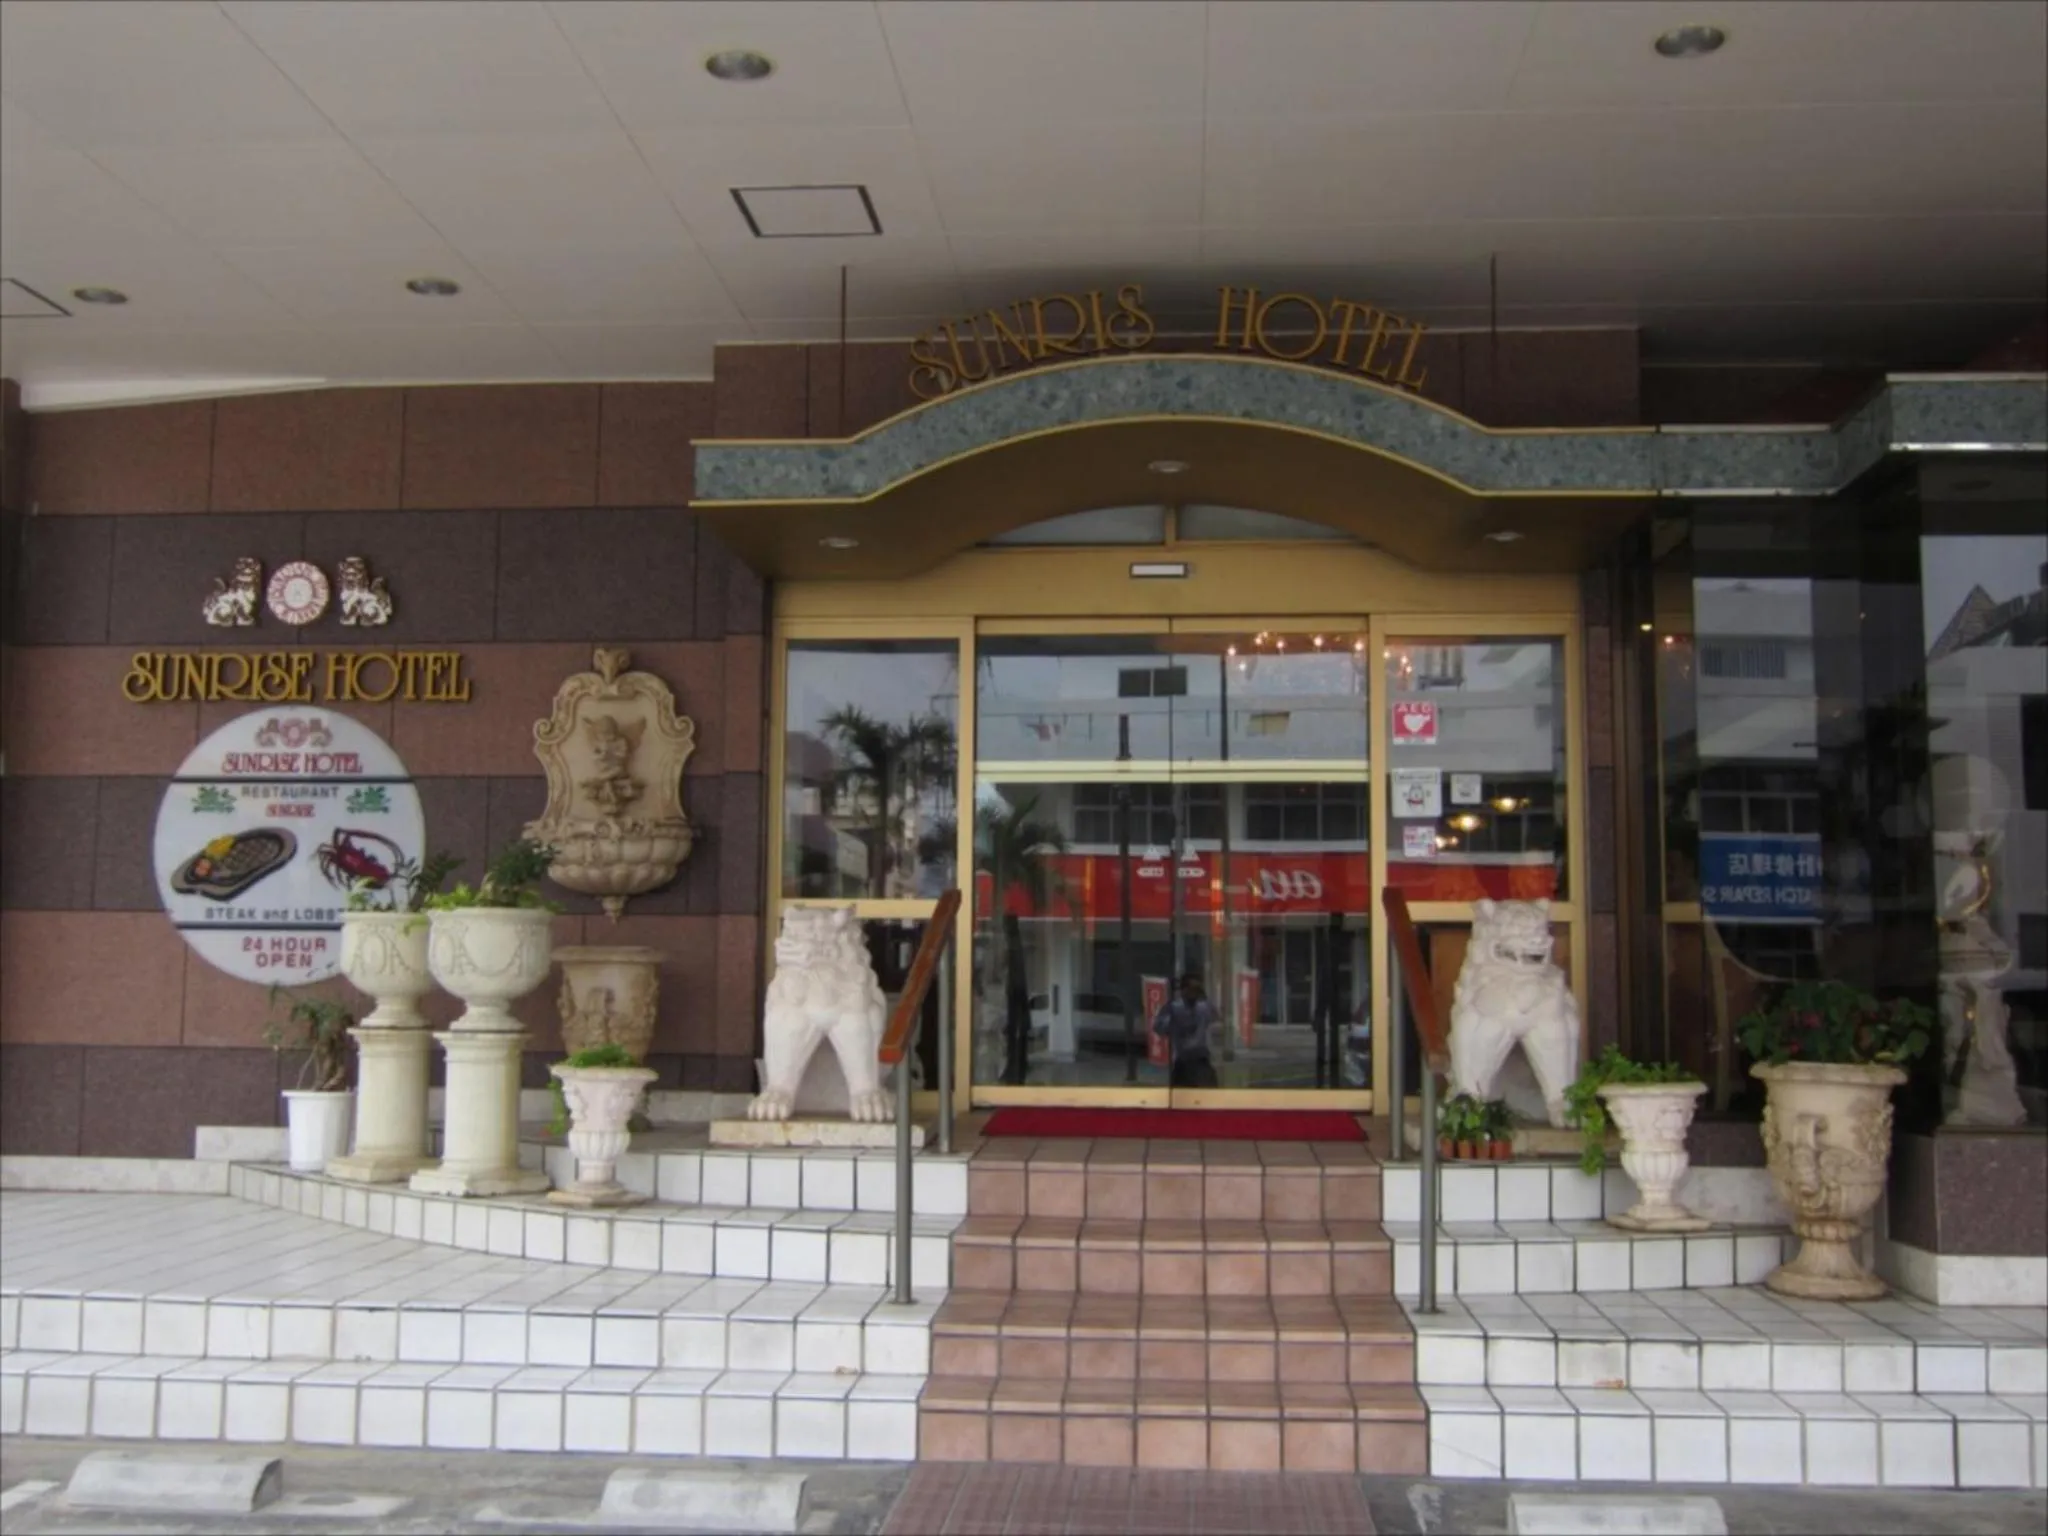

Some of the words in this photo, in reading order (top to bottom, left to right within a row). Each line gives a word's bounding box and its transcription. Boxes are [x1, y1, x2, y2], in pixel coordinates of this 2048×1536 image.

[909, 284, 1155, 401] SUNRIS
[1214, 285, 1429, 392] HOTEL
[121, 651, 313, 702] SUNRISE
[322, 651, 471, 702] HOTEL
[221, 753, 300, 774] SUNRISE
[304, 753, 363, 774] HOTEL
[241, 786, 340, 799] RESTAURANT
[205, 907, 257, 920] STEAK
[263, 909, 289, 920] and
[242, 936, 263, 952] 24
[270, 937, 327, 952] HOUR
[256, 953, 312, 968] OPEN
